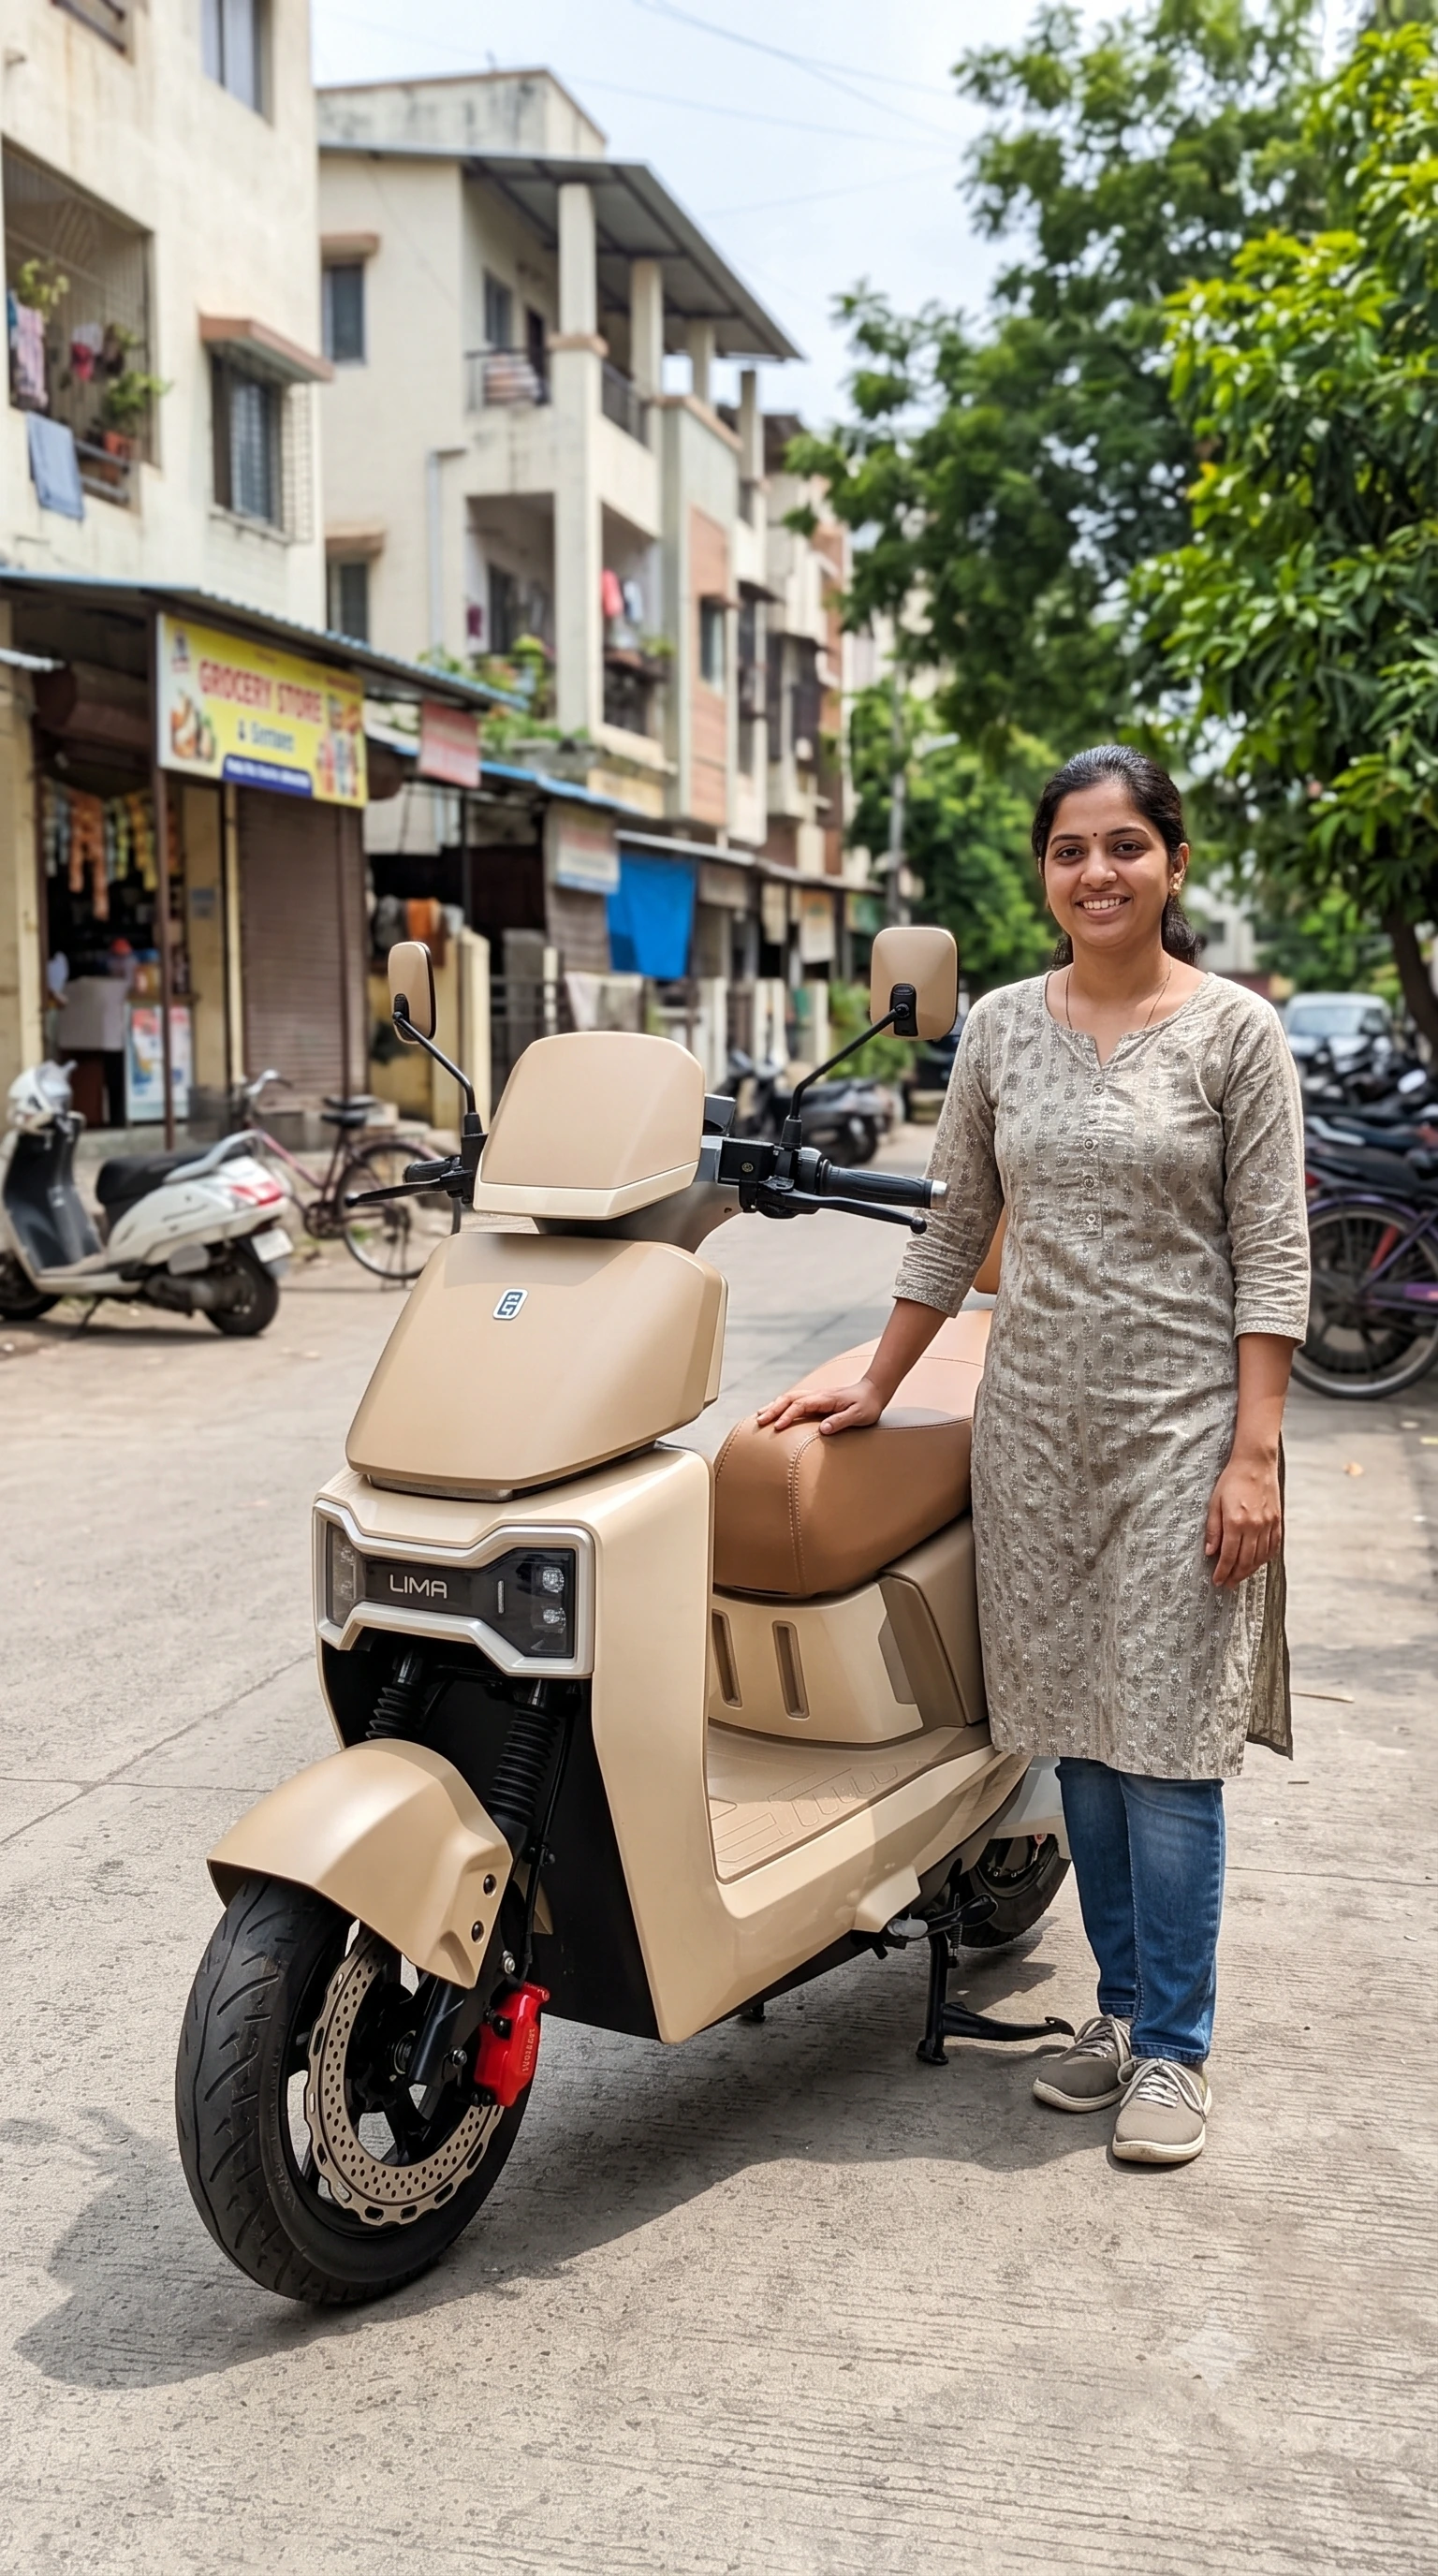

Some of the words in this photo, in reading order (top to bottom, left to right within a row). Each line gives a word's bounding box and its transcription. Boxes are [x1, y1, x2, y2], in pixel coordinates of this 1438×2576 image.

[199, 658, 271, 711] GROCERY
[278, 682, 322, 724] STORE
[389, 1573, 448, 1599] LIMA
